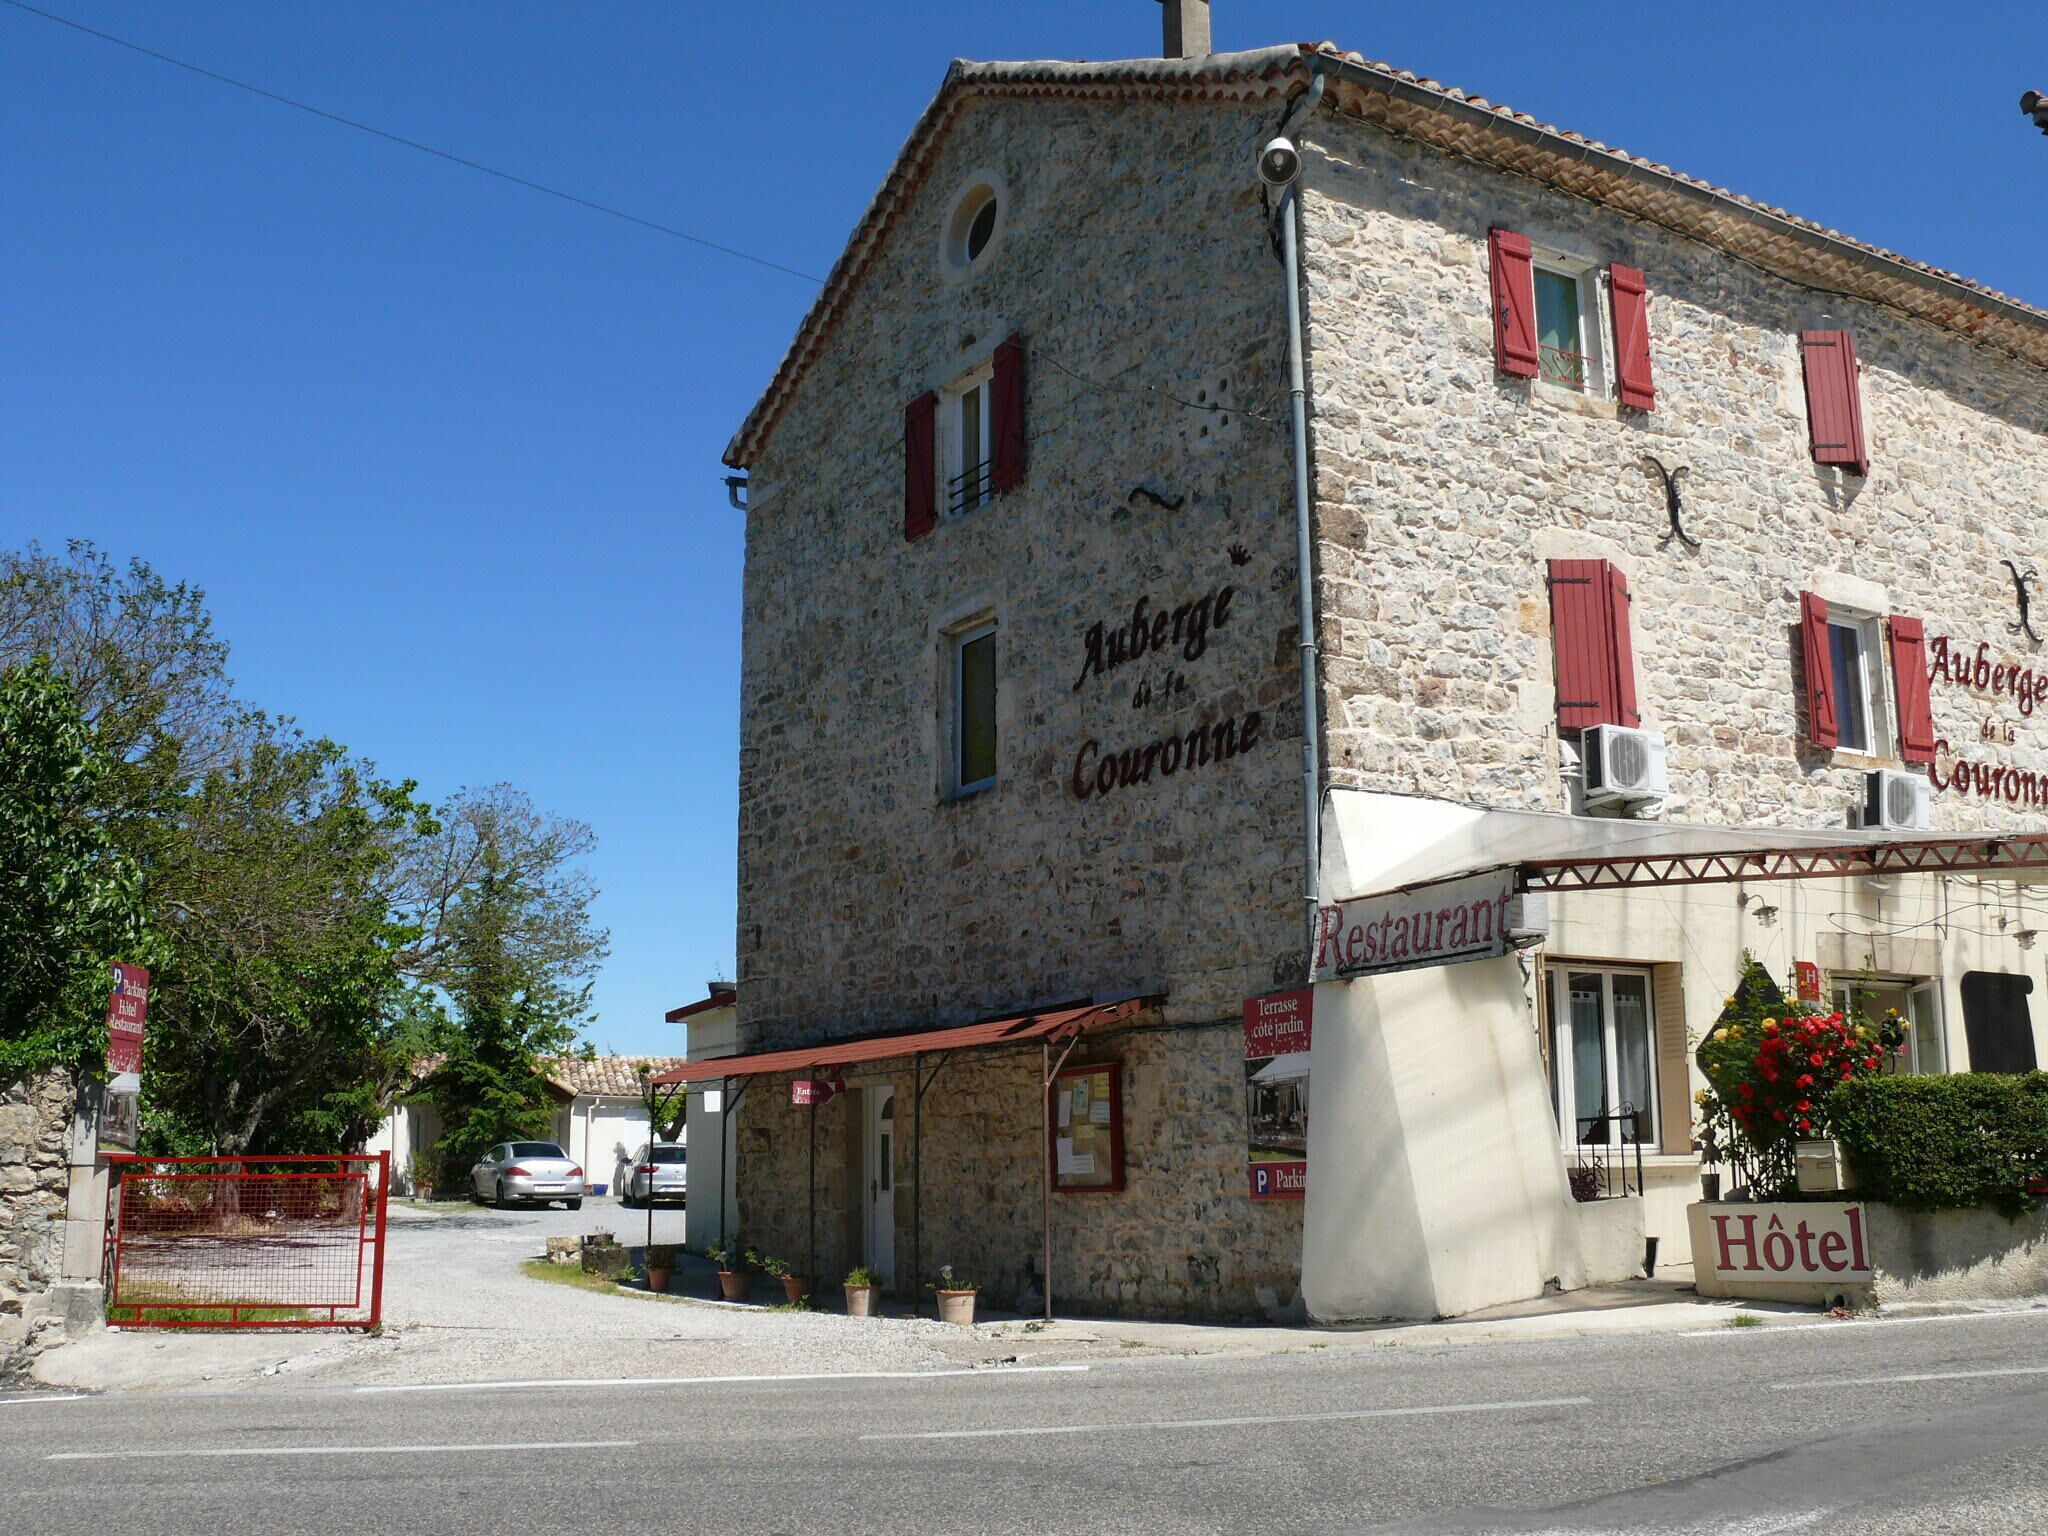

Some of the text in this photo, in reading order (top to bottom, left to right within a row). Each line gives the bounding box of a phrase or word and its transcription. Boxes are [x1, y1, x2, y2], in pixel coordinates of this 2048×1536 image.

[1073, 585, 1234, 691] Auberge
[1929, 636, 2048, 716] Auberge
[1132, 678, 1151, 709] de
[1981, 716, 2015, 742] de la
[1073, 711, 1262, 800] Couronne
[1315, 885, 1509, 967] Restaurant
[1806, 969, 1816, 984] H
[123, 978, 147, 1005] Parking
[1257, 997, 1298, 1017] Terrasse
[111, 1014, 143, 1034] Restaurant
[1253, 1017, 1304, 1041] côté jardin
[1257, 1170, 1267, 1193] P
[1709, 1207, 1869, 1272] Hôtel
